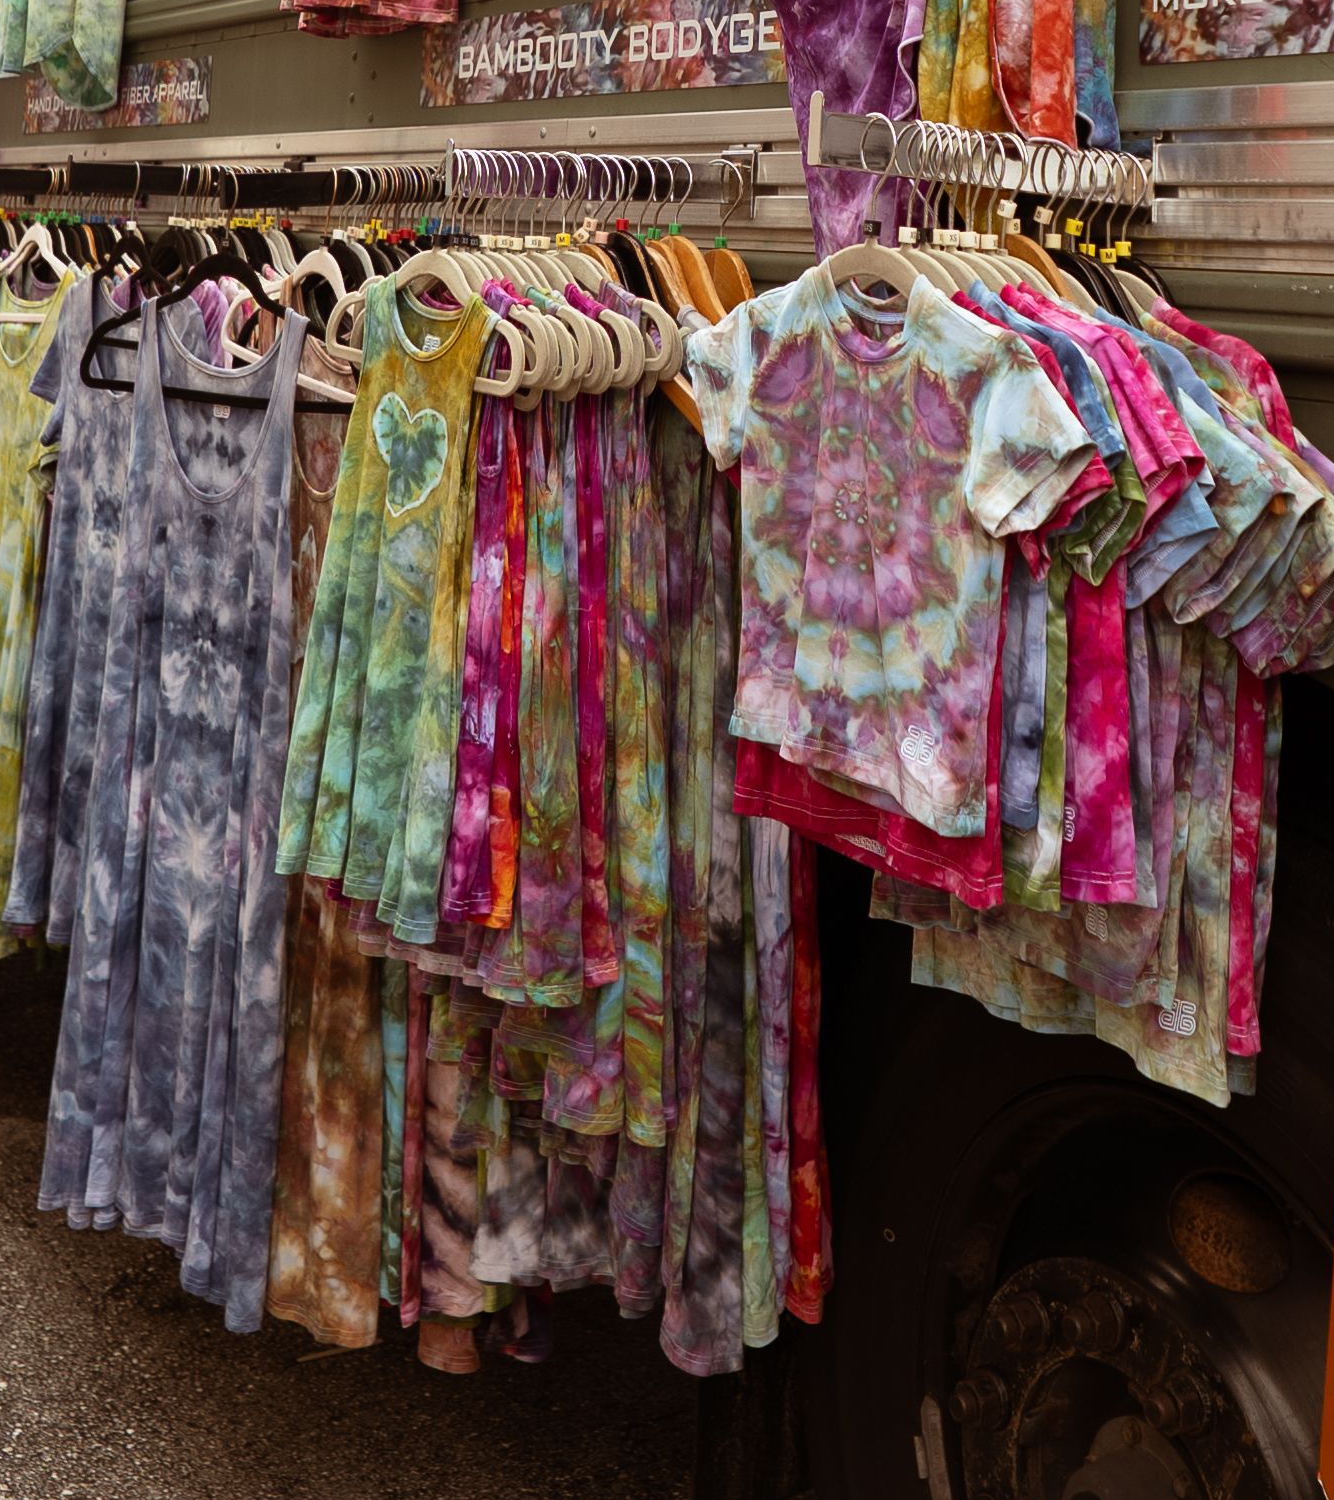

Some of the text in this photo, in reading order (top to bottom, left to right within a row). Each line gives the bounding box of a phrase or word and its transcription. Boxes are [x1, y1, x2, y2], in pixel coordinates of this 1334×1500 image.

[458, 9, 784, 80] BAMBOOTY BODYGE
[27, 97, 51, 114] HAND
[121, 85, 151, 105] FIBER
[152, 79, 204, 104] APPAREL
